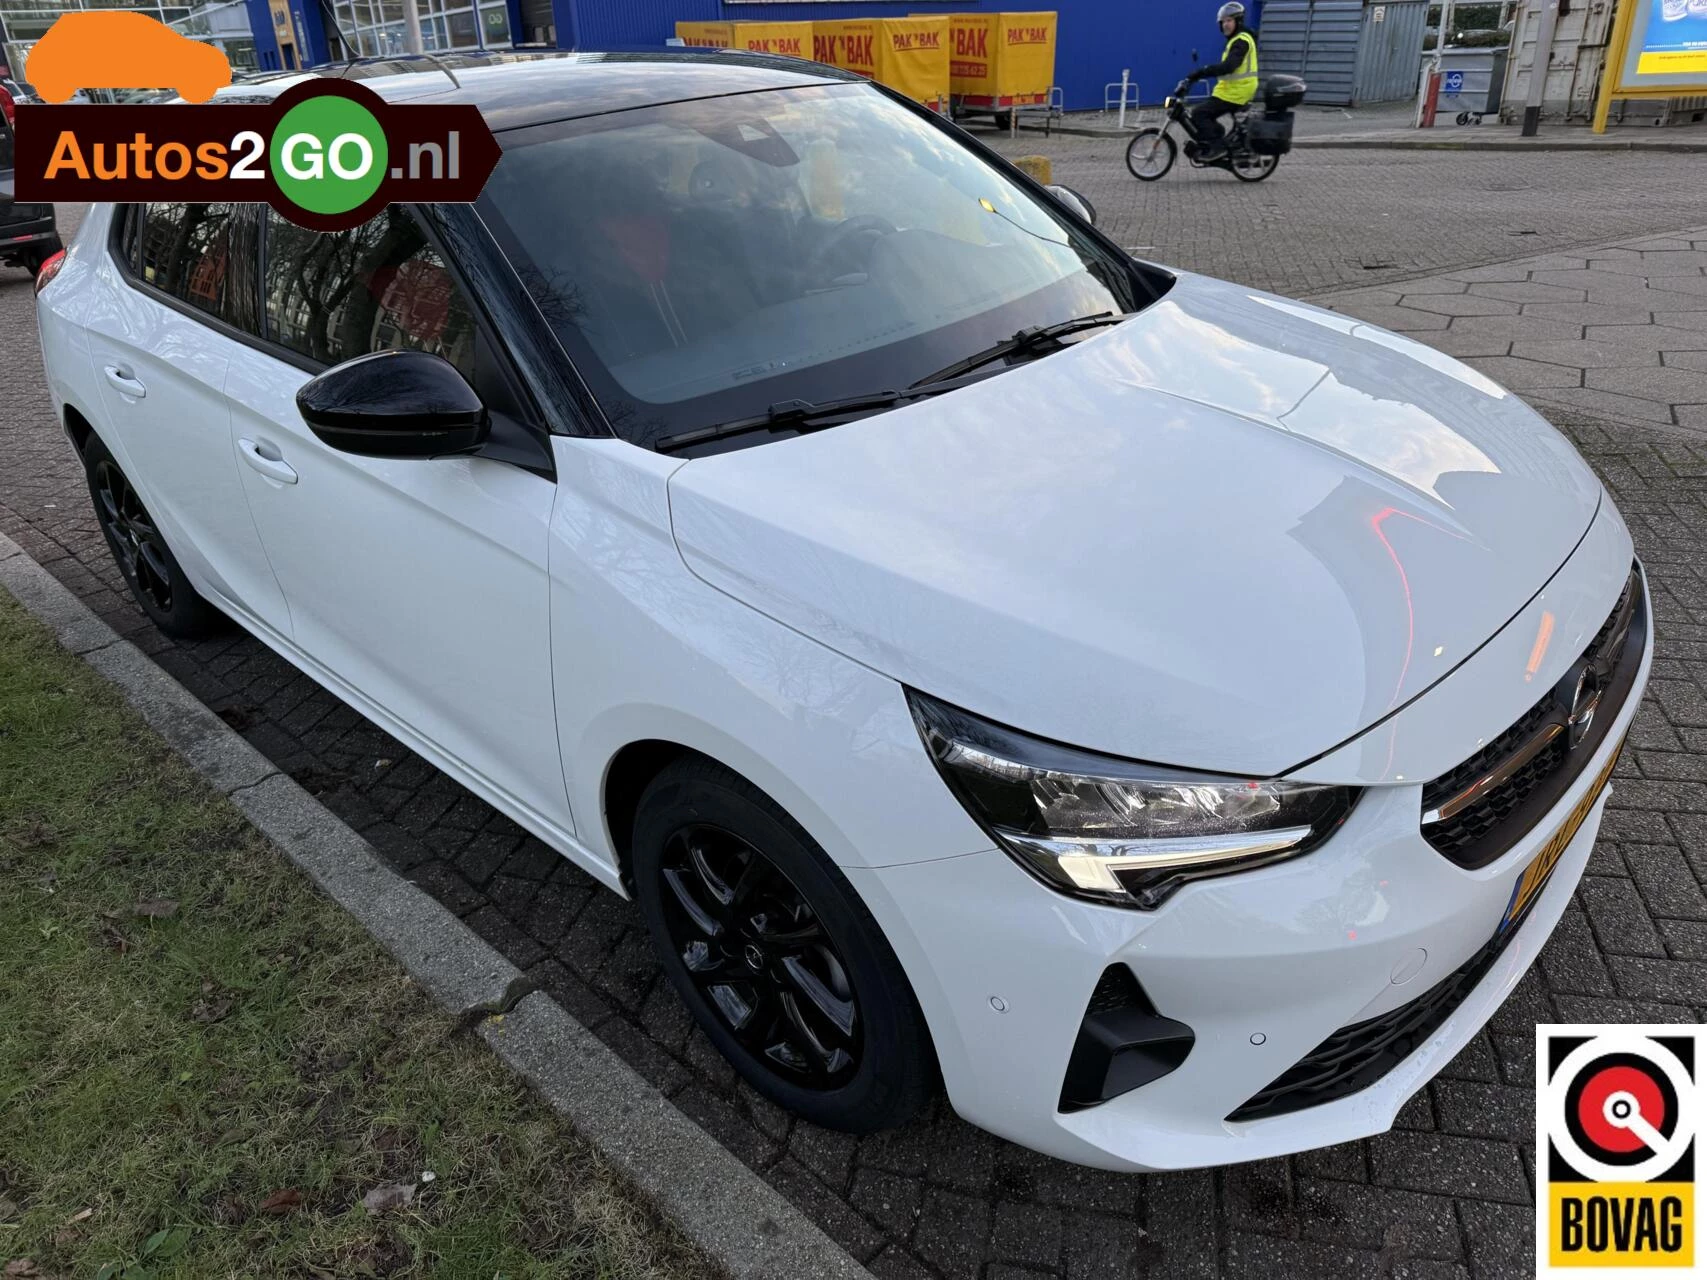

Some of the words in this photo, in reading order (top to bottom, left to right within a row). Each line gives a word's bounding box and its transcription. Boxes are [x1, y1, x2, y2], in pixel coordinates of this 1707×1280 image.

[893, 33, 913, 48] PAK
[919, 31, 940, 47] BAK
[957, 28, 988, 58] BAK
[1007, 28, 1024, 43] PAK
[1030, 26, 1048, 42] BAK
[747, 39, 770, 53] PAK
[777, 37, 801, 53] BAK
[813, 35, 837, 64] PAK
[846, 35, 874, 66] BAK
